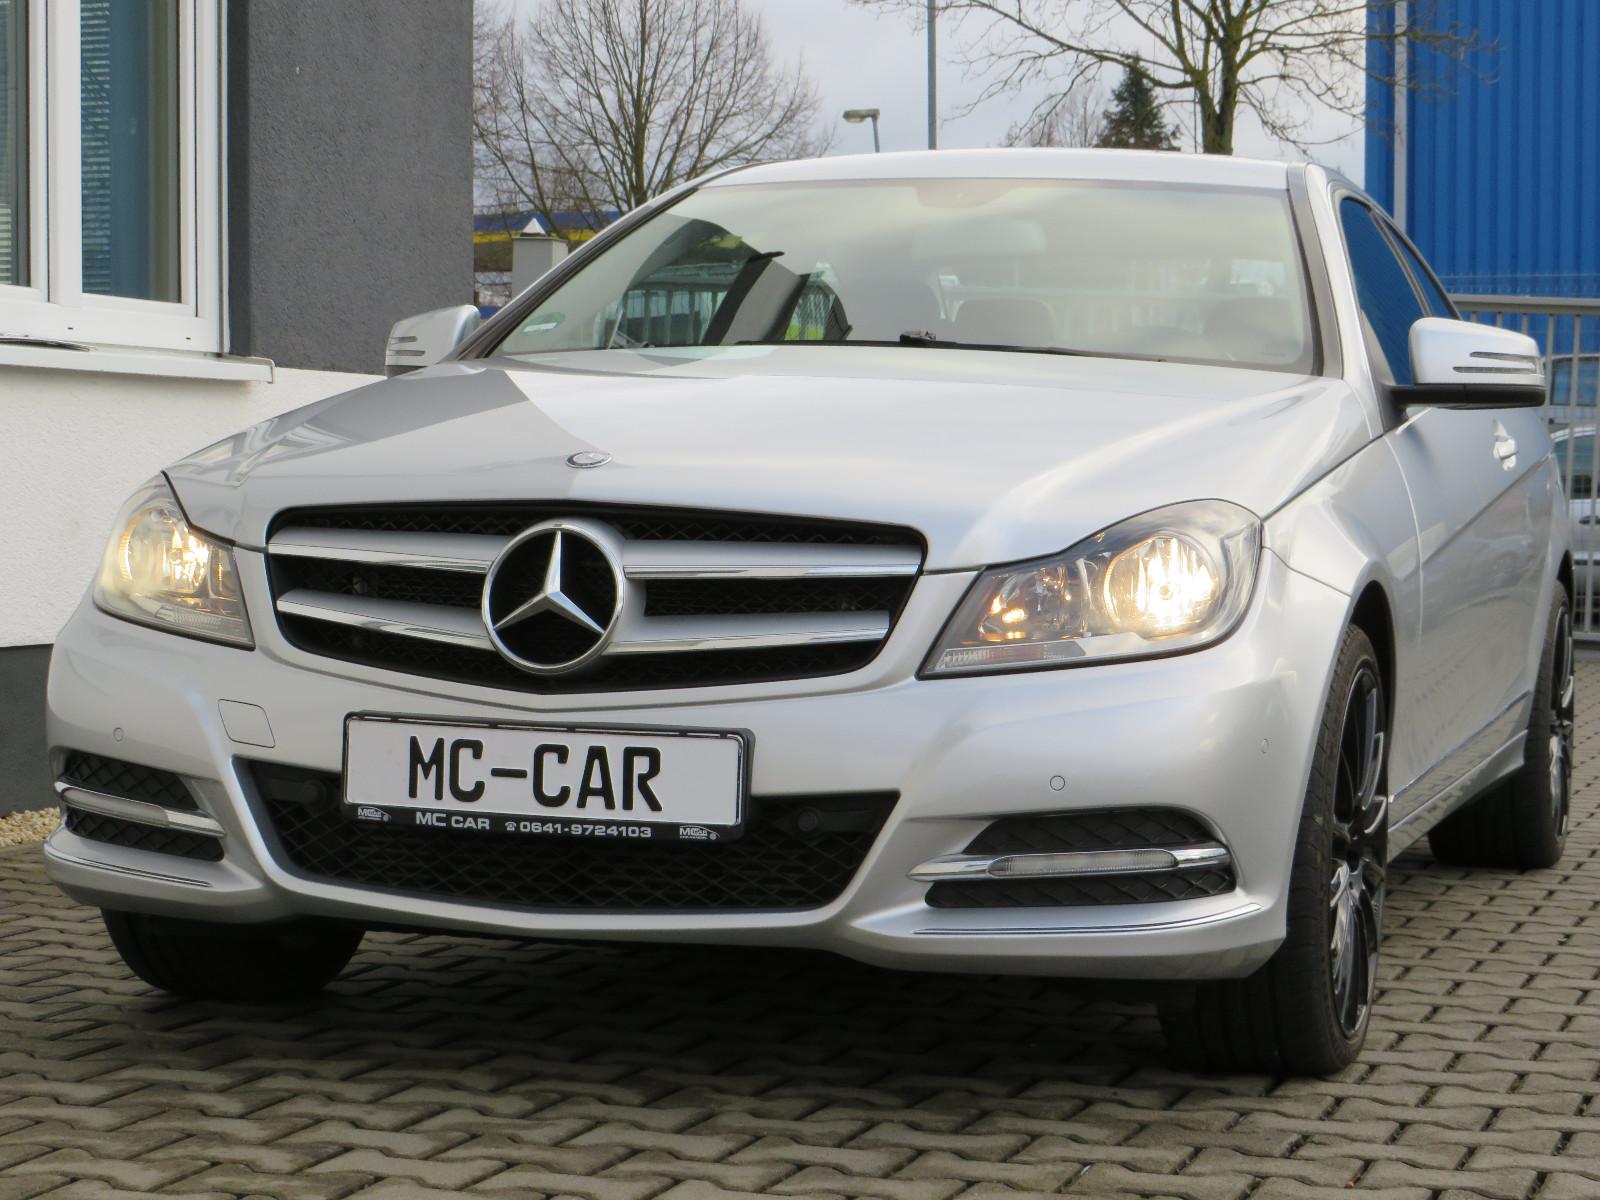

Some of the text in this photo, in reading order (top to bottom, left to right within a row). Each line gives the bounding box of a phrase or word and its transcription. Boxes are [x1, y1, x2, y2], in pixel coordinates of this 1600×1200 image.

[408, 735, 663, 812] MC-CAR
[416, 811, 652, 838] MC CAR 0641-9724103
